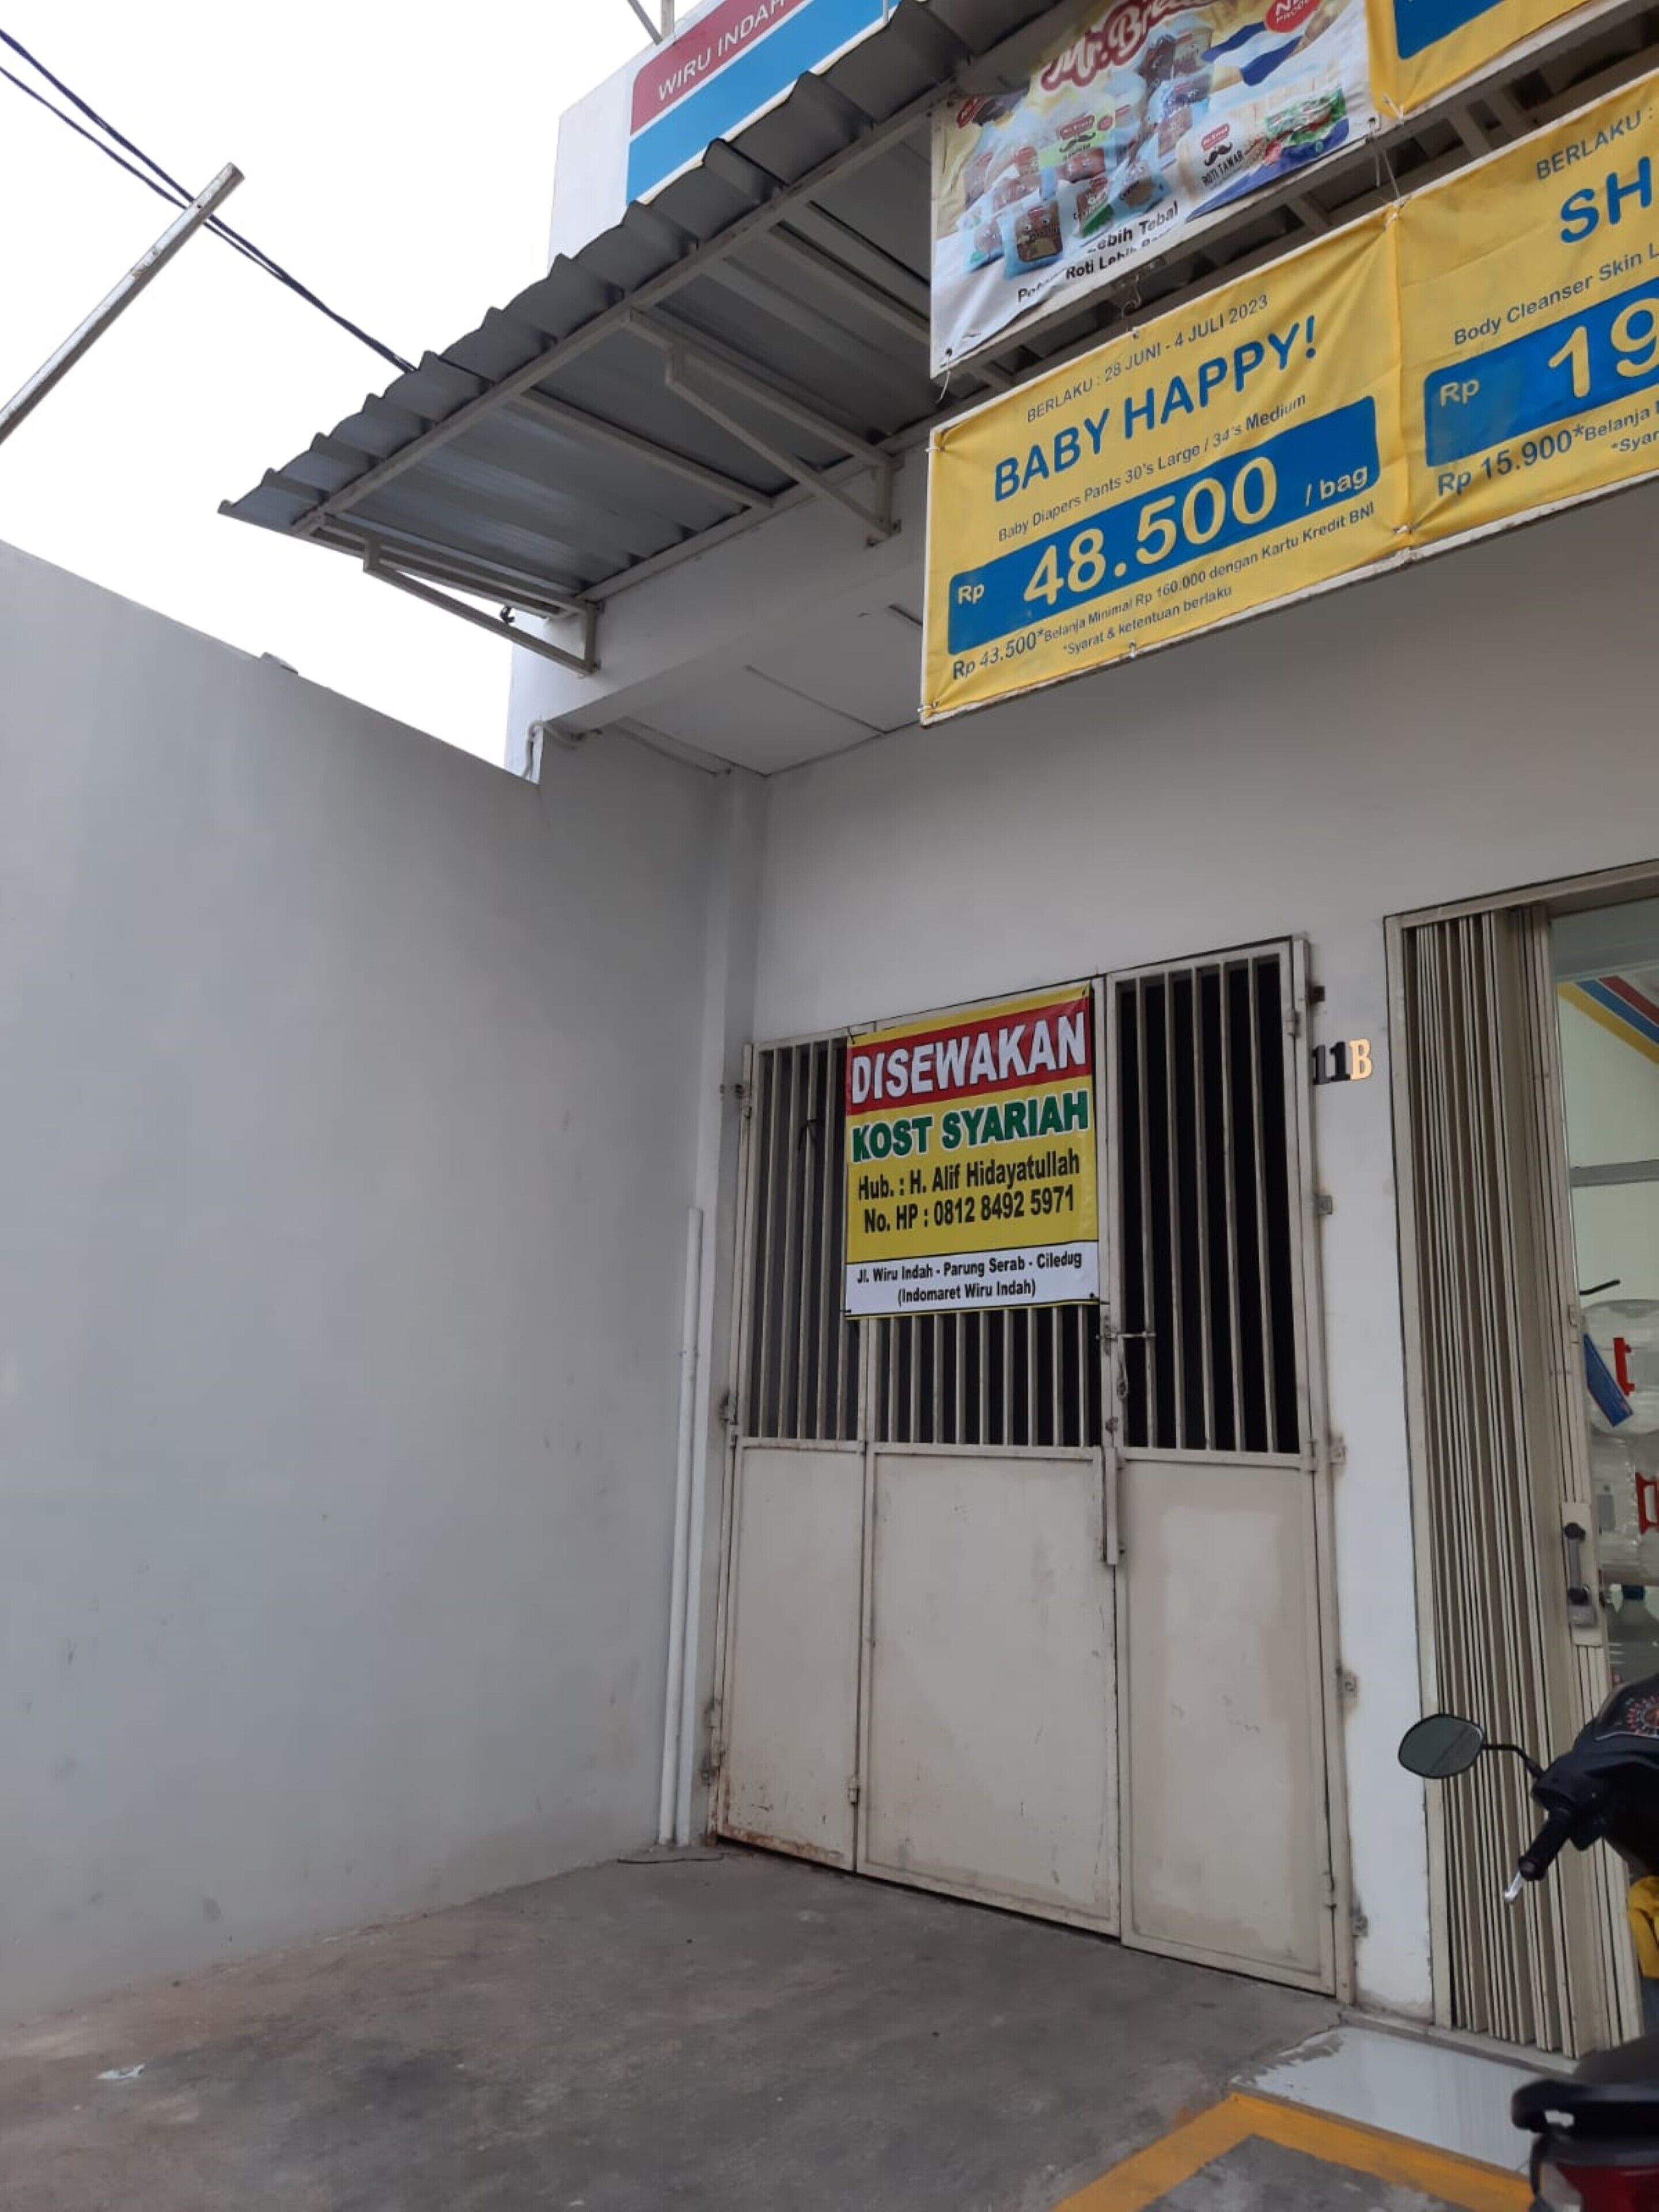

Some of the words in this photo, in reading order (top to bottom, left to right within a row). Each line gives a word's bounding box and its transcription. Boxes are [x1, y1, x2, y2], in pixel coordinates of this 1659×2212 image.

[659, 46, 711, 101] WIRU
[1536, 111, 1642, 180] BERLAKU
[1138, 199, 1179, 234] Tebal
[1560, 156, 1653, 244] SH
[1065, 259, 1094, 280] Roti
[1454, 317, 1501, 345] Body
[1507, 275, 1593, 323] Cleanser
[1599, 253, 1642, 281] Skin
[1027, 378, 1093, 423] BERLAKU
[1105, 359, 1122, 382] 28
[1126, 342, 1161, 370] JUNI
[1174, 331, 1183, 347] 4
[1188, 313, 1224, 342] JULI
[1229, 294, 1268, 324] 2023
[1440, 378, 1480, 407] Rp
[1547, 297, 1659, 398] 19
[994, 408, 1110, 502] BABY
[1124, 315, 1316, 440] HAPPY!
[998, 520, 1029, 543] Baby
[1032, 496, 1081, 528] Diapers
[1084, 475, 1122, 502] Pants
[1157, 444, 1201, 471] Large
[1246, 394, 1306, 431] Medium
[1438, 471, 1472, 498] Rp
[958, 584, 985, 605] Rp
[1023, 455, 1277, 605] 48.500
[1319, 465, 1368, 500] bag
[953, 660, 975, 680] Rp
[1088, 598, 1133, 625] Minimal
[1135, 592, 1152, 608] Rp
[1157, 570, 1206, 597] 160.000
[1210, 552, 1259, 579] dengan
[1262, 536, 1298, 559] Kartu
[1302, 516, 1346, 543] Kredit
[1350, 501, 1374, 525] BNI
[1107, 627, 1116, 639] &
[1119, 605, 1180, 635] ketentuan
[1184, 586, 1232, 612] berlaku
[852, 1011, 1086, 1105] DISEWAKAN
[1312, 1039, 1372, 1085] 11B
[852, 1115, 934, 1163] KOST
[942, 1090, 1089, 1150] SYARIAH
[858, 1173, 895, 1202] Hub.
[910, 1169, 927, 1195] H.
[932, 1164, 961, 1192] Alif
[967, 1148, 1081, 1190] Hidayatullah
[865, 1208, 891, 1234] No.
[896, 1202, 919, 1230] HP
[934, 1196, 975, 1227] 0812
[980, 1190, 1025, 1222] 8492
[1031, 1184, 1074, 1217] 5971
[873, 1266, 898, 1283] Wiru
[902, 1263, 933, 1281] Indah
[944, 1259, 986, 1278] Parung
[989, 1255, 1025, 1274] Serab
[1037, 1249, 1082, 1270] Ciledug
[897, 1285, 961, 1307] (Indomaret
[965, 1282, 993, 1298] Wiru
[997, 1277, 1036, 1299] Indah)
